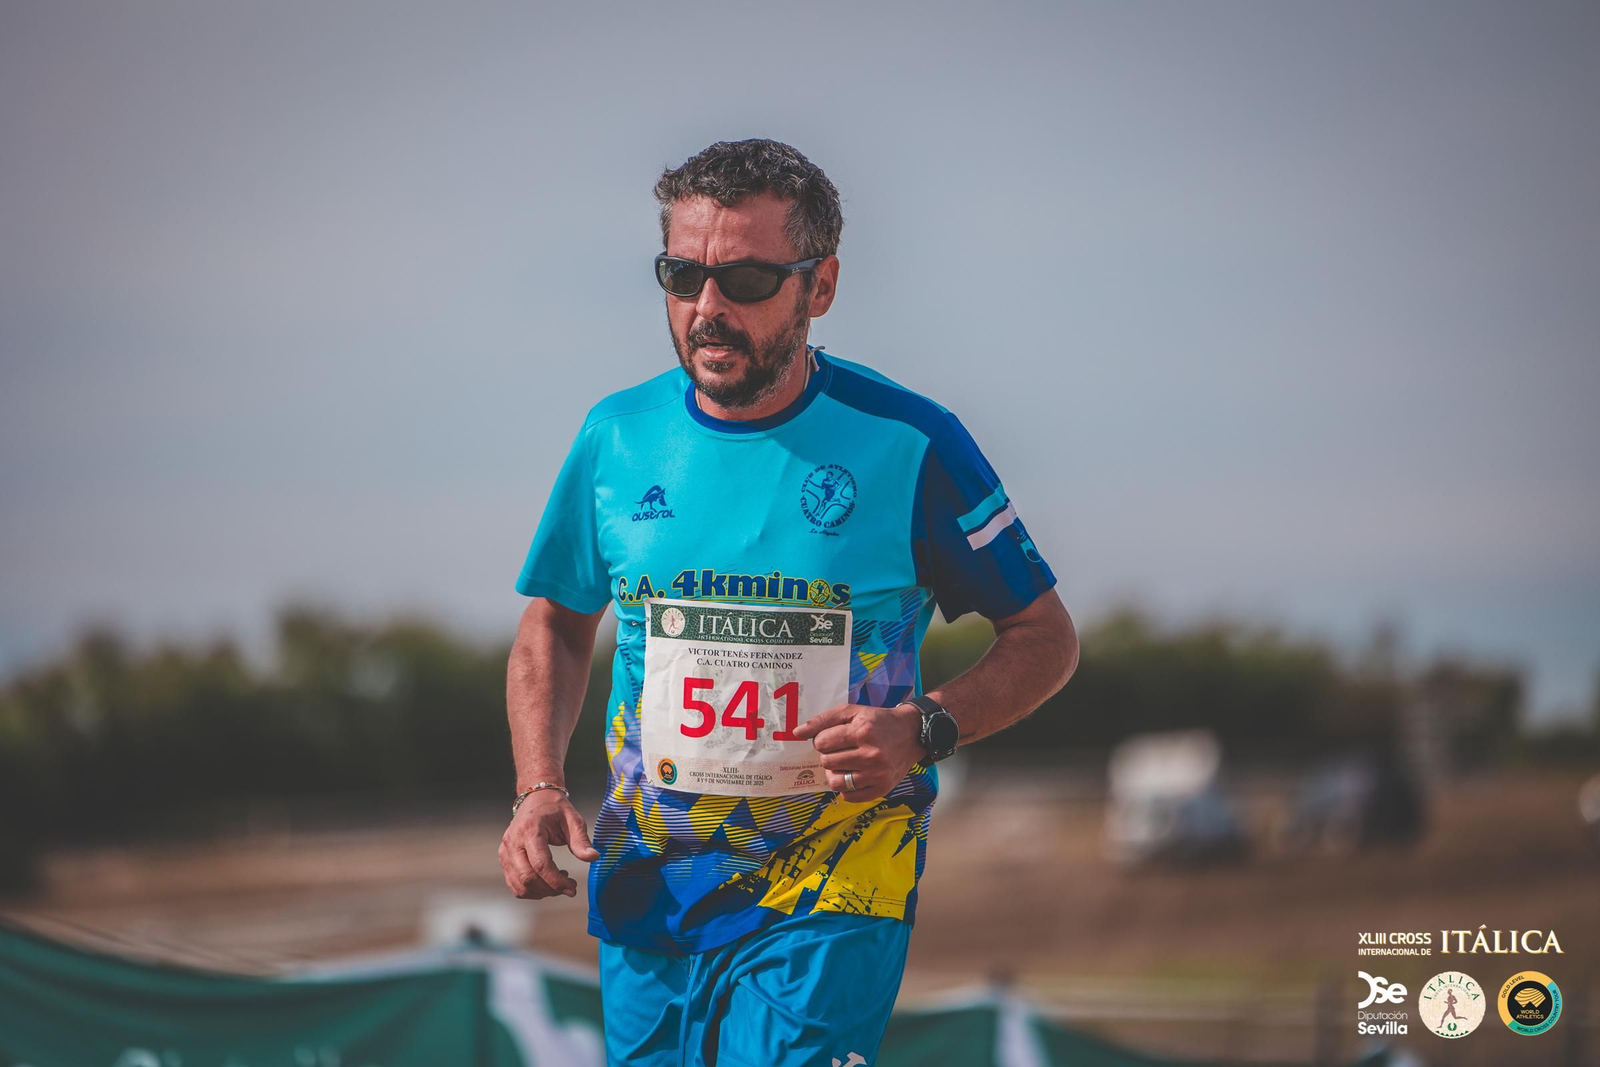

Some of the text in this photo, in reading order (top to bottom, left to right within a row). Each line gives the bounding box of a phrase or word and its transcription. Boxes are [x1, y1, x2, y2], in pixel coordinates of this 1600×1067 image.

[814, 465, 826, 473] DE
[800, 497, 856, 529] CUATRO CAMINOS
[618, 574, 666, 602] C.A.
[698, 612, 794, 638] ITÁLICA
[810, 636, 833, 644] Sevilla
[688, 647, 803, 660] VICTOR TENÉS FERNANDEZ
[696, 658, 793, 669] C.A. CUATRO CAMINOS
[680, 677, 808, 741] 541
[705, 772, 745, 780] INTERNACIONAL
